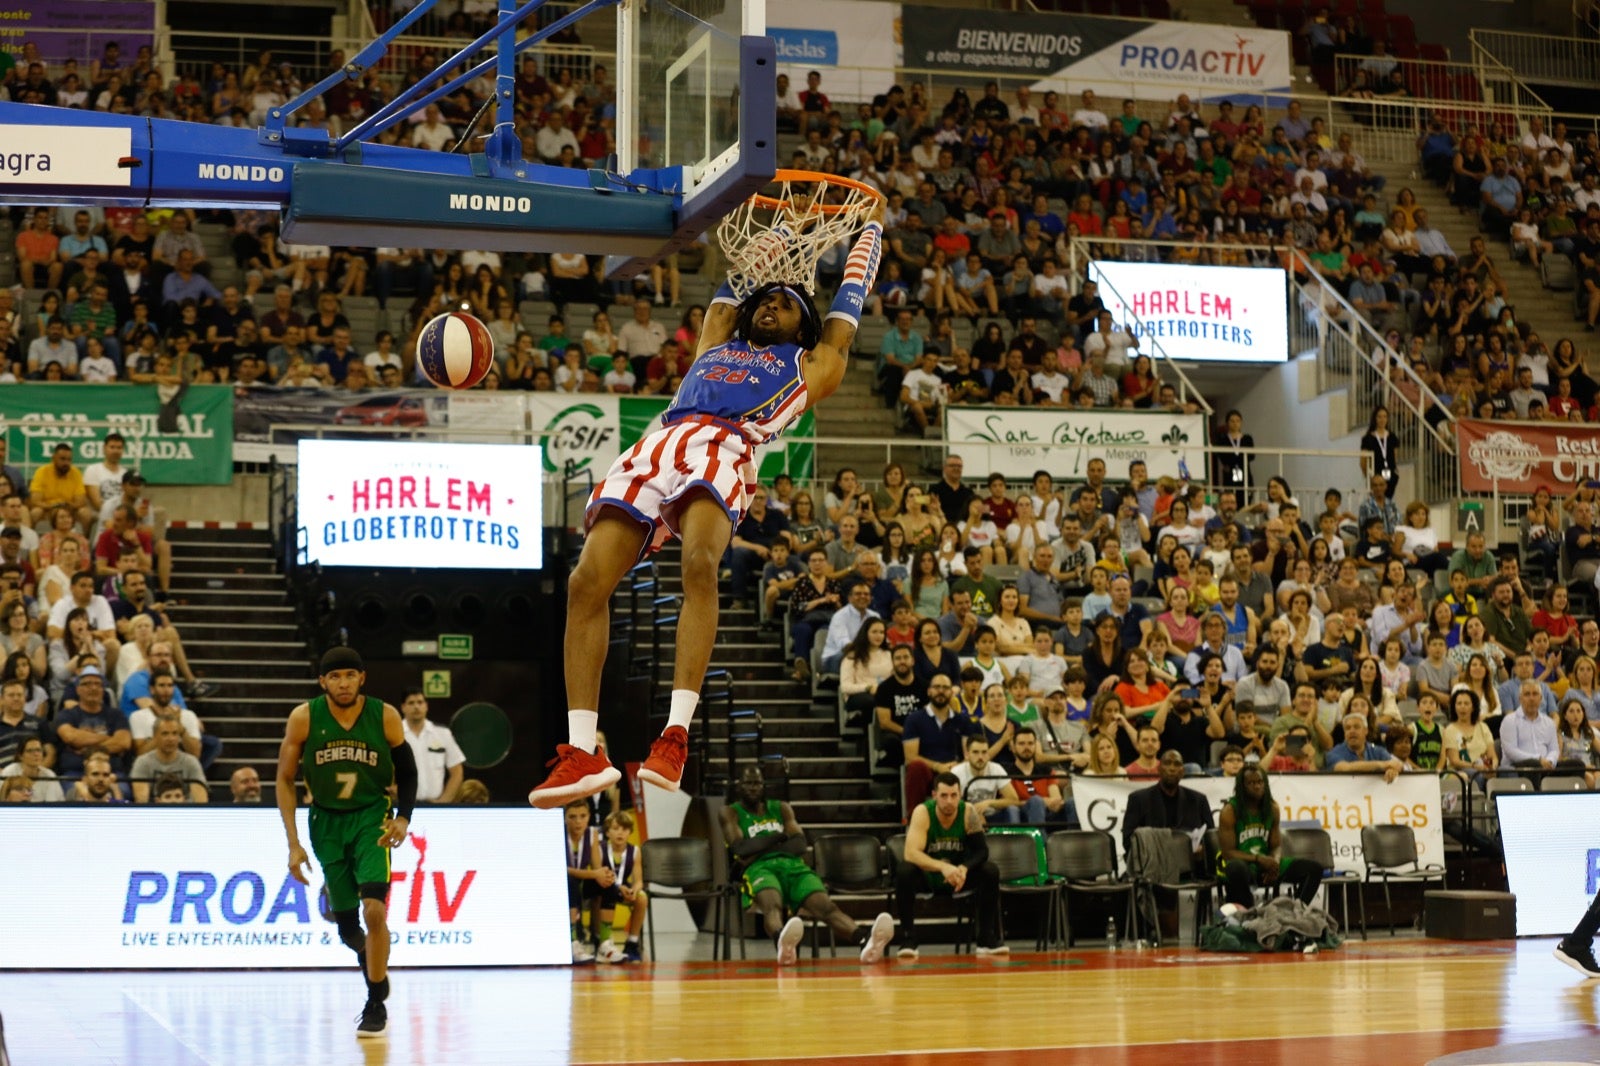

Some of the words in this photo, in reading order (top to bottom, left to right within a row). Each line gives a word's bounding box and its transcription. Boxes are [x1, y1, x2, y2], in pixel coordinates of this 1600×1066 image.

[957, 29, 1082, 55] BIENVENIDOS
[926, 51, 934, 62] a
[937, 52, 960, 62] otro
[1035, 56, 1050, 68] de
[1120, 44, 1265, 77] PROACTIV
[199, 163, 284, 182] MONDO
[450, 194, 531, 213] MONDO
[1133, 290, 1233, 320] HARLEM
[19, 413, 97, 437] CAJA
[106, 413, 214, 438] RUAL
[553, 425, 614, 451] CSIF
[965, 415, 1039, 443] San
[1009, 447, 1036, 457] 1990
[353, 476, 491, 516] HARLEM
[324, 516, 519, 549] GLOBETROTTERS
[1465, 510, 1479, 531] A
[315, 746, 378, 766] GENERALS
[336, 772, 358, 799] 7
[122, 932, 160, 946] LIVE
[166, 931, 313, 946] ENTERTAINMENT
[320, 931, 333, 944] &
[408, 930, 473, 945] EVENTS
